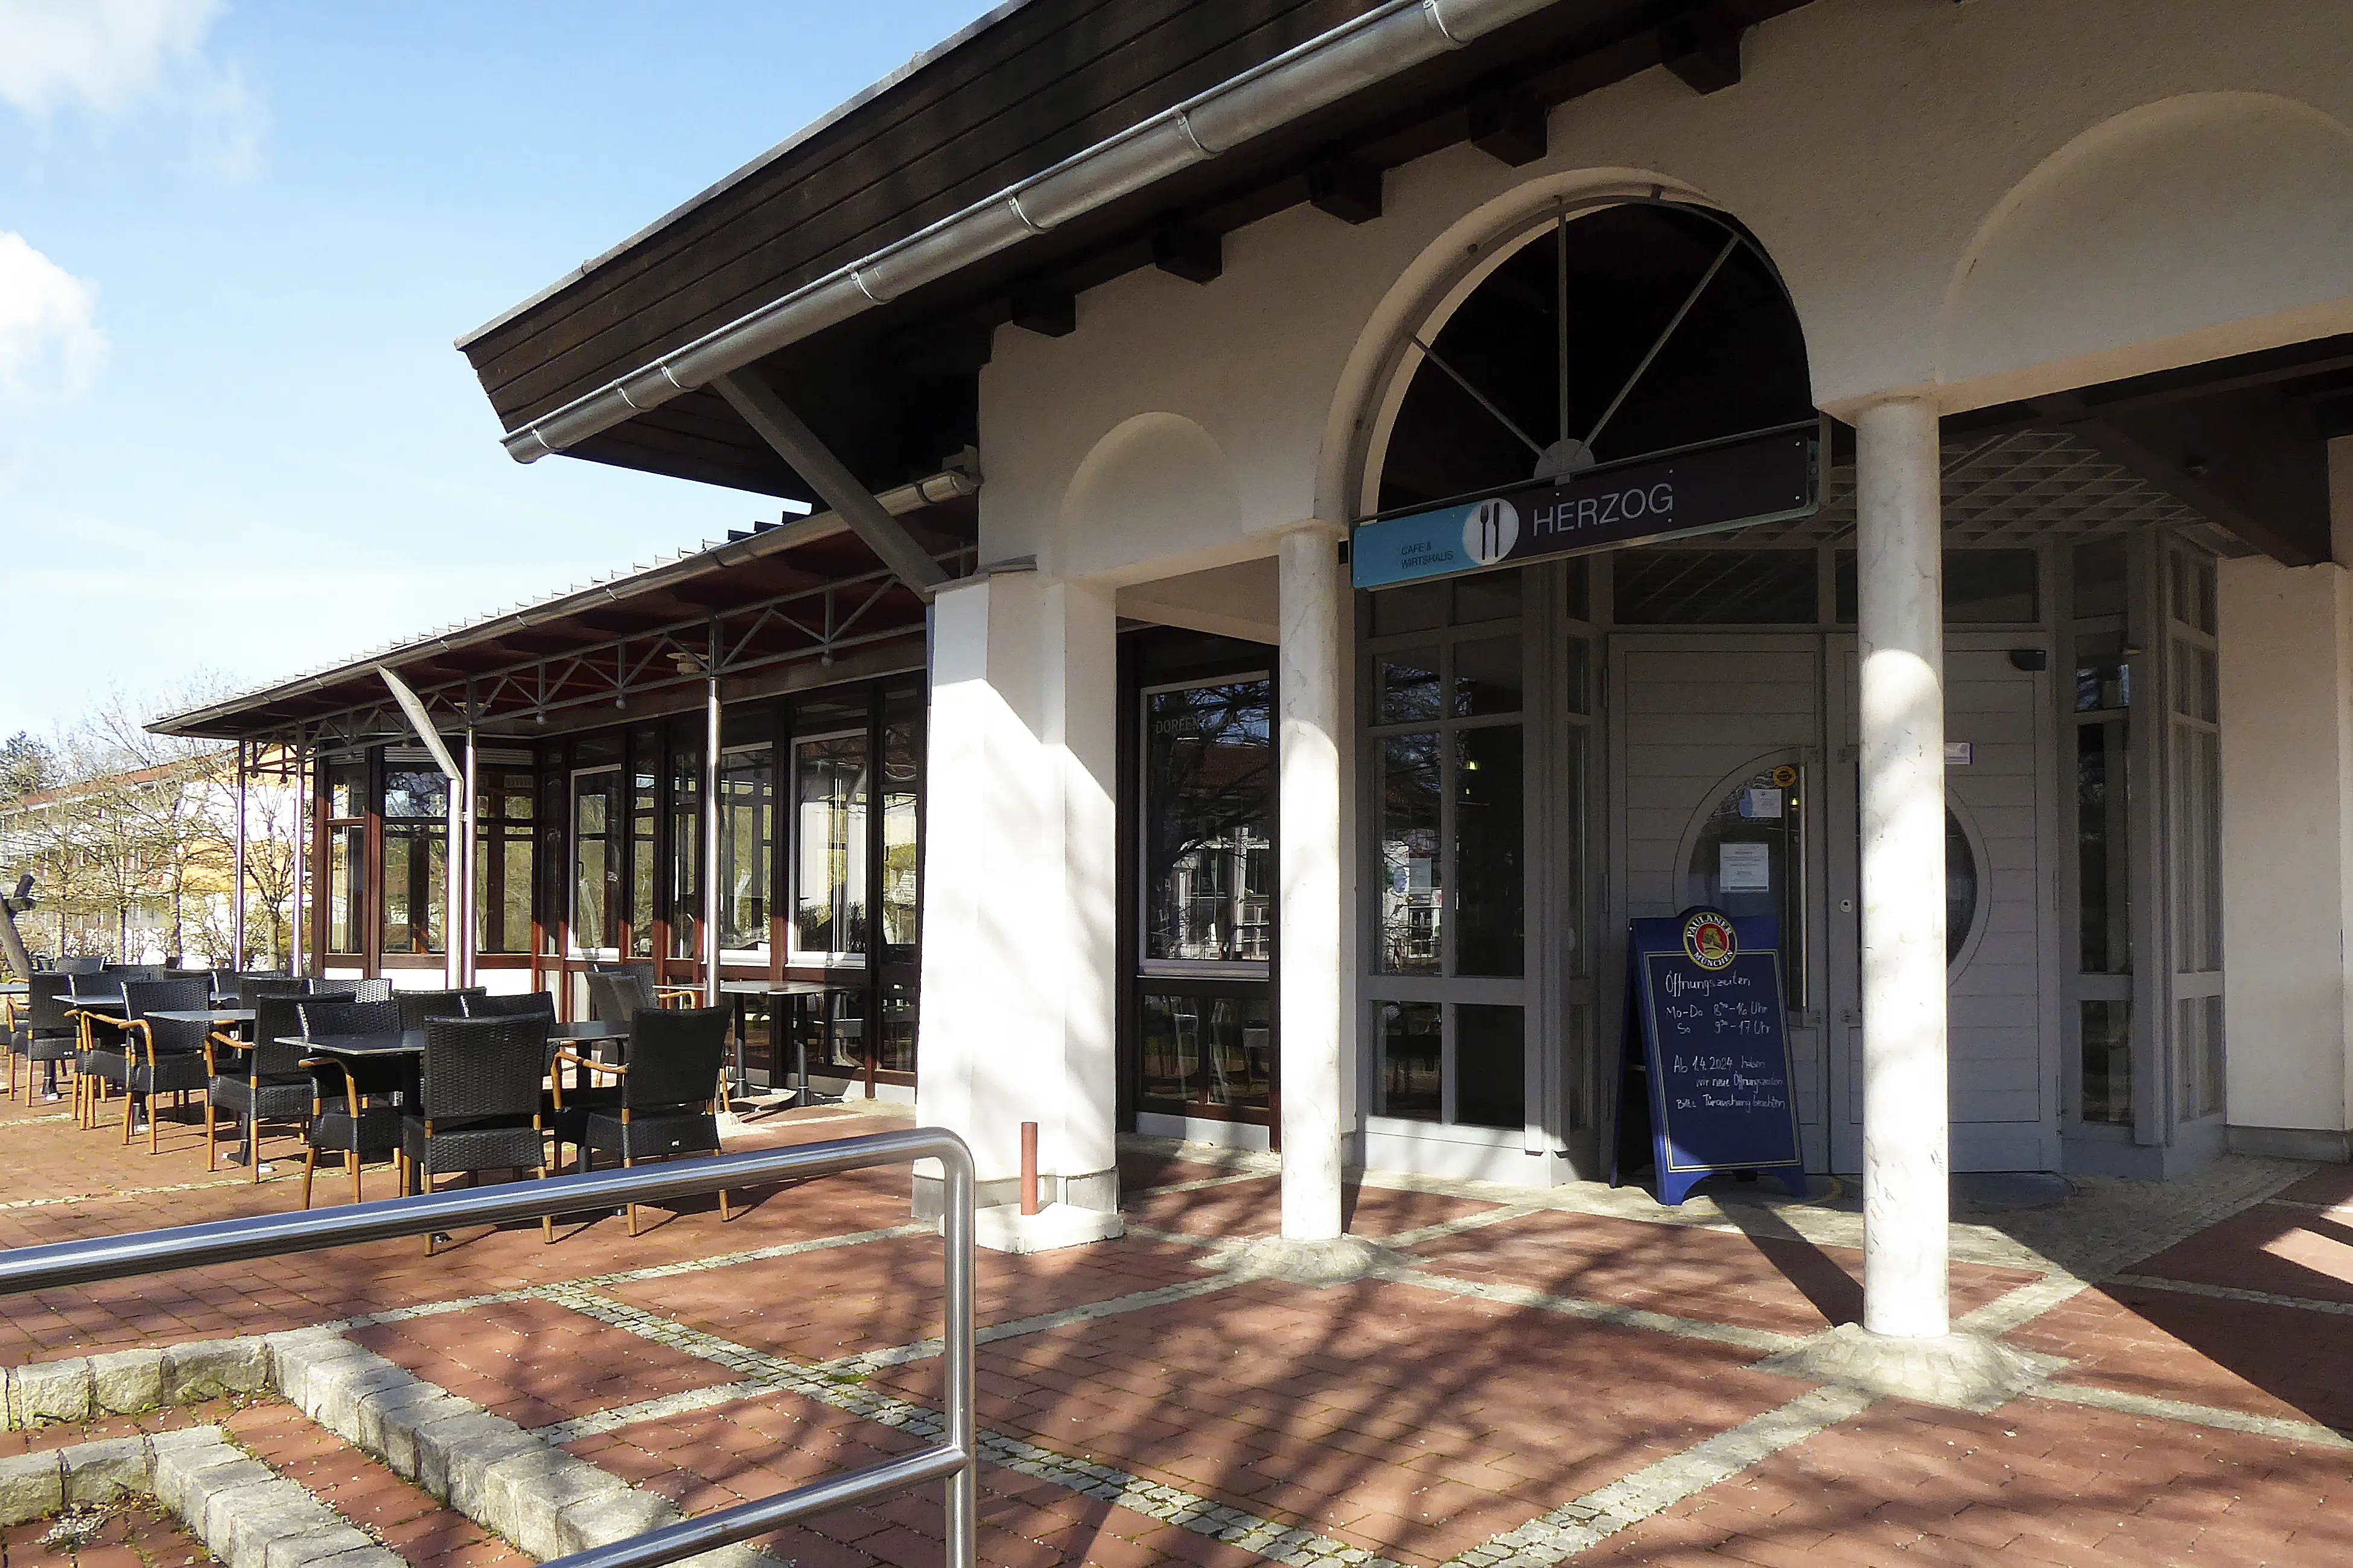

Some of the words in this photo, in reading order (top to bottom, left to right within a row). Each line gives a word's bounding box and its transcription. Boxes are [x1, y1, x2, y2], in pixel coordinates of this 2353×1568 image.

[1533, 482, 1673, 537] HERZOG
[1401, 550, 1453, 569] WIRTSHAUS
[1687, 915, 1732, 938] PAULANER
[1665, 970, 1751, 997] Öffnungszeiten
[1751, 1000, 1768, 1015] Uhr
[1754, 1020, 1771, 1035] Uhr
[1673, 1055, 1689, 1073] Ab
[1741, 1055, 1765, 1069] haben
[1695, 1076, 1710, 1088] wir
[1733, 1070, 1783, 1094] Öffnungszeiten
[1702, 1094, 1751, 1113] Türaushang
